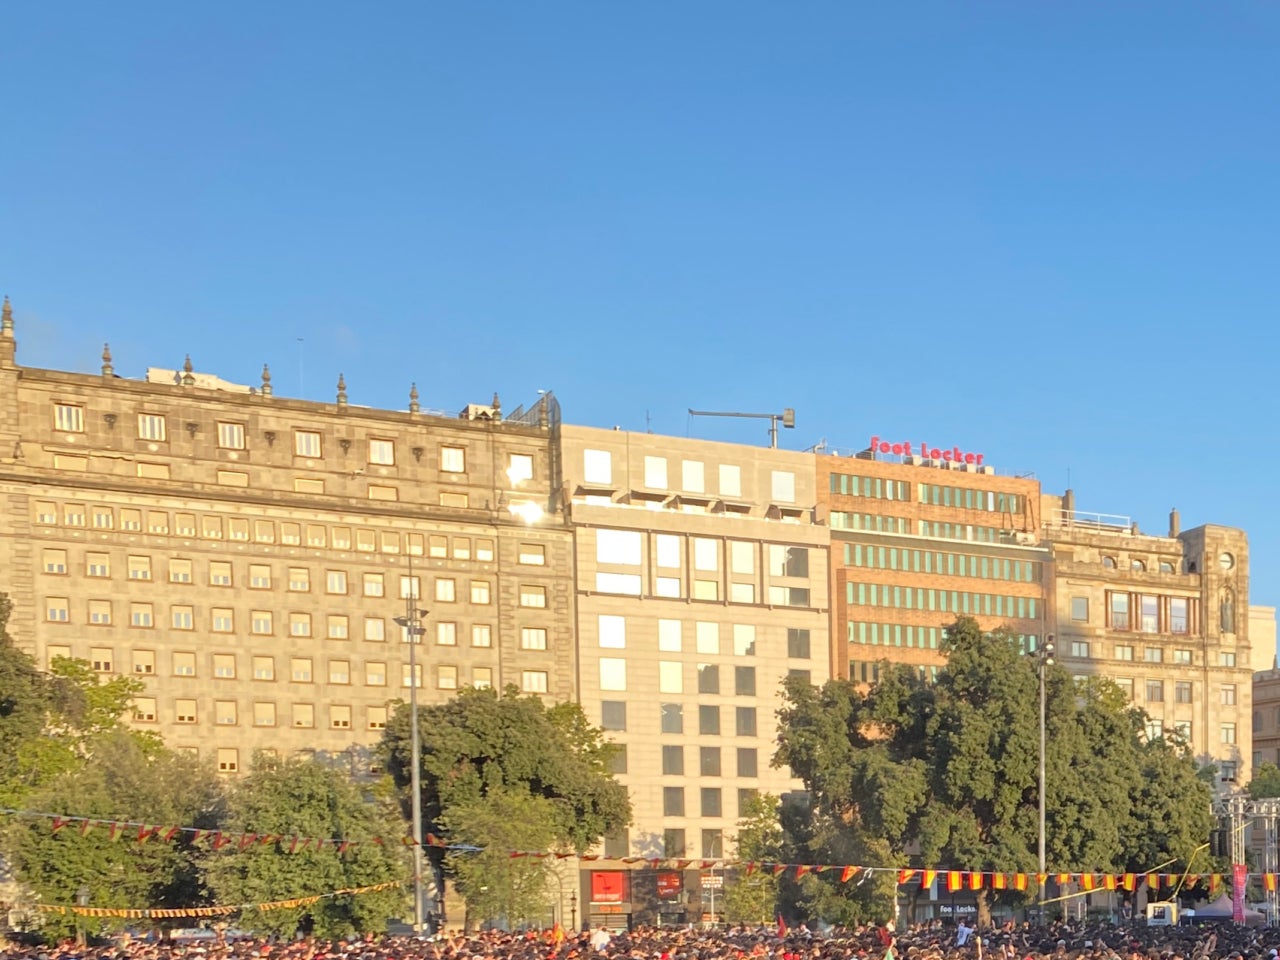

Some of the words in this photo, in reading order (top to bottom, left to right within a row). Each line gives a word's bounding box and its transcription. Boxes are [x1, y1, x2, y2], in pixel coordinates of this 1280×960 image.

[870, 435, 912, 457] Foot
[921, 442, 984, 465] Locker
[940, 905, 954, 913] Foo
